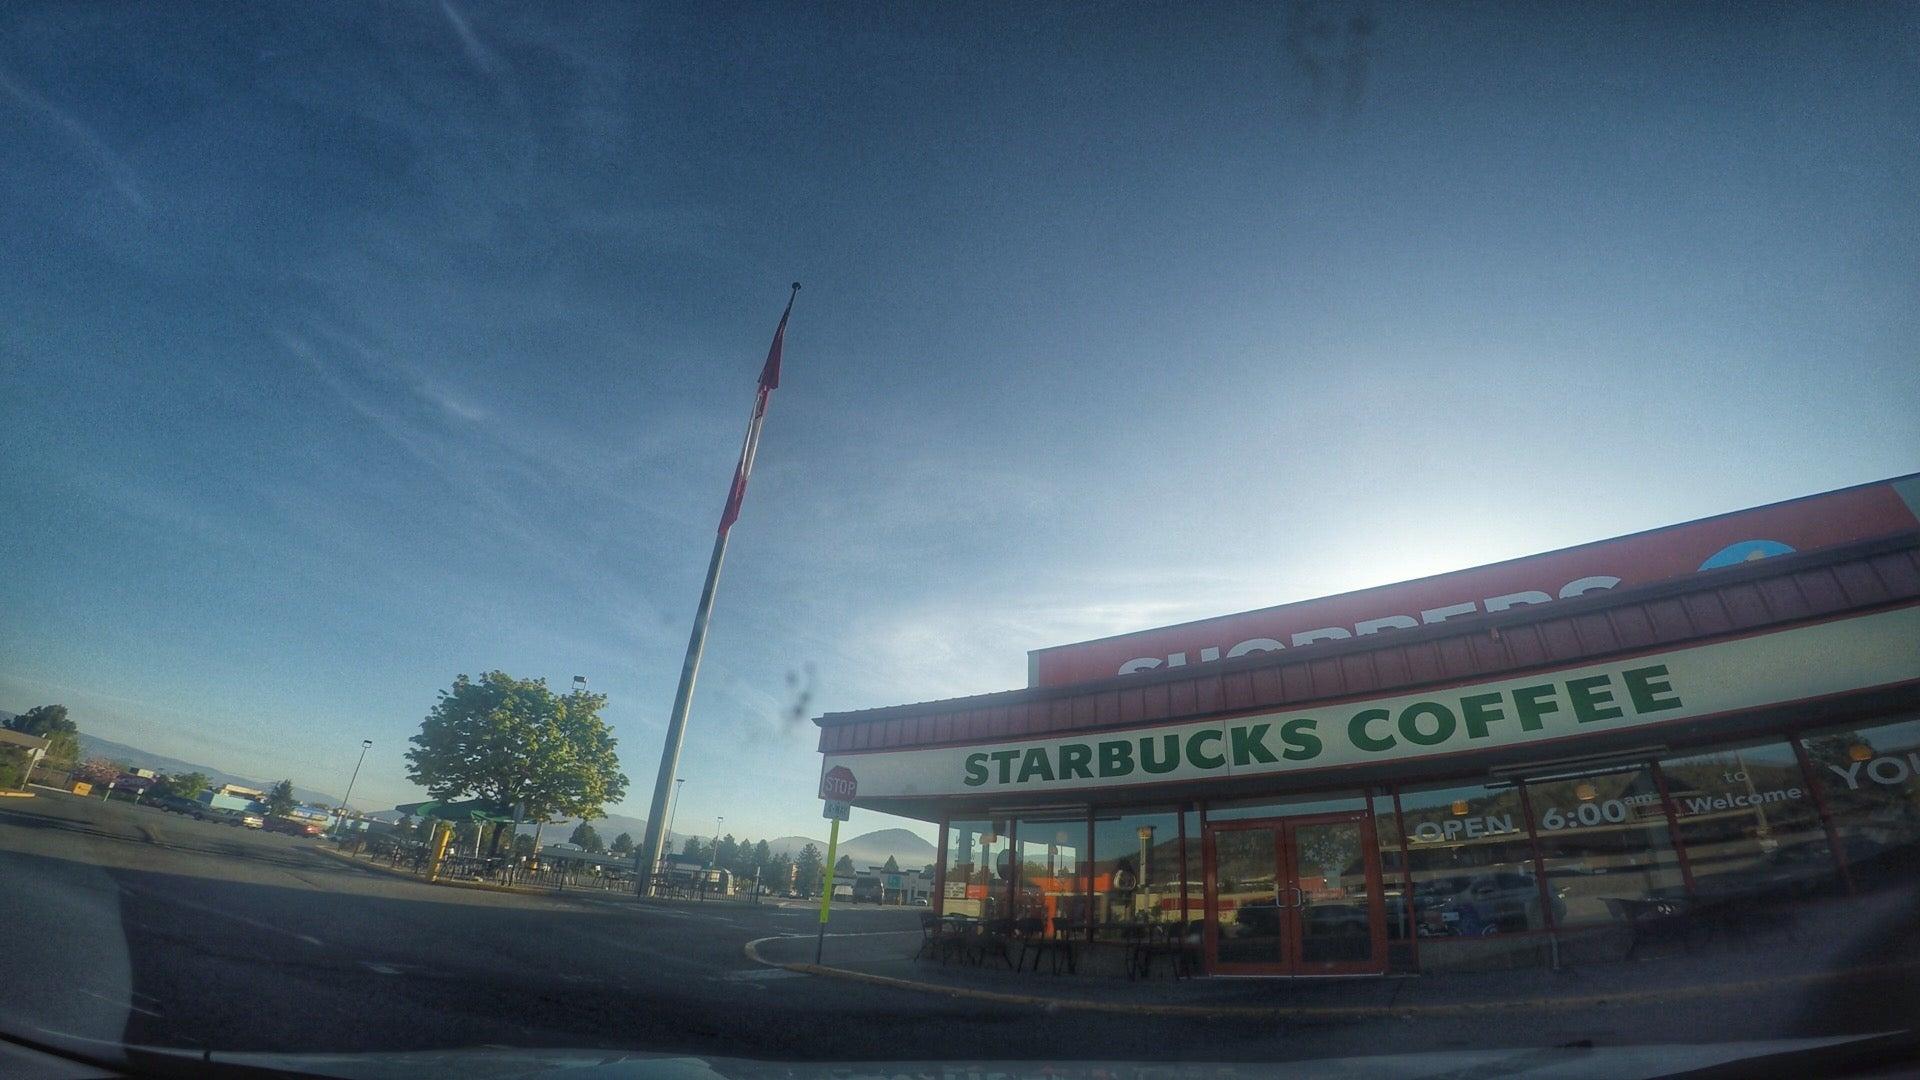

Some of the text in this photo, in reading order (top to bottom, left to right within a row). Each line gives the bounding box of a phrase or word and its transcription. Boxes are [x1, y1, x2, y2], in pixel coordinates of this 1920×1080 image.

[963, 664, 1683, 787] STARBUCKS COFFEE
[825, 776, 856, 796] STOP
[1722, 769, 1748, 784] to
[1686, 787, 1802, 814] Welcome
[1414, 814, 1513, 841] OPEN
